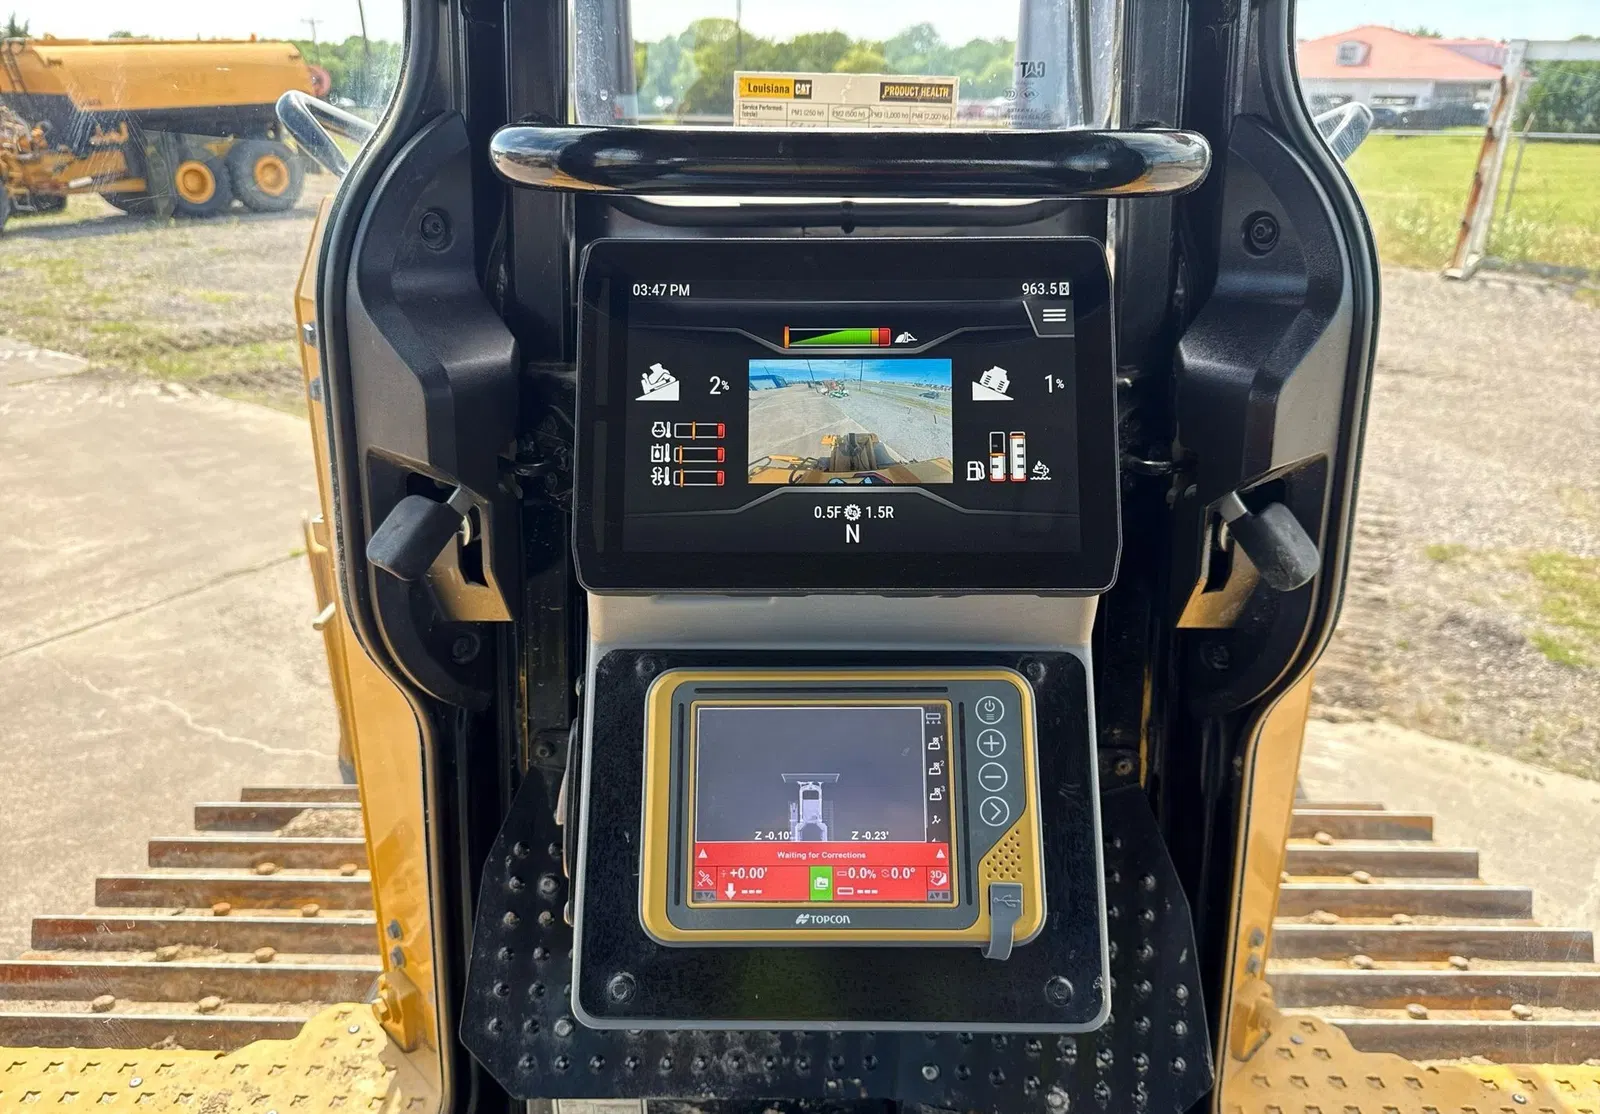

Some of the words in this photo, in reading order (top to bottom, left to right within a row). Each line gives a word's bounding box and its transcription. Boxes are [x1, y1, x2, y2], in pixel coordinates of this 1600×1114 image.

[747, 82, 790, 94] Louisiana
[795, 83, 811, 95] CAT
[884, 85, 918, 97] PRODUCT
[920, 86, 949, 98] HEALTH
[632, 283, 667, 296] 03:47
[669, 283, 690, 296] PM
[1021, 282, 1058, 295] 963.5
[814, 505, 842, 519] 0.5F
[865, 505, 894, 519] 1.5R
[845, 523, 860, 543] N
[754, 831, 762, 840] Z
[851, 830, 859, 840] Z
[777, 851, 807, 860] Waiting
[808, 851, 819, 859] for
[821, 851, 867, 859] Corrections
[847, 866, 877, 879] 0.0%
[810, 914, 851, 925] TOPCON
